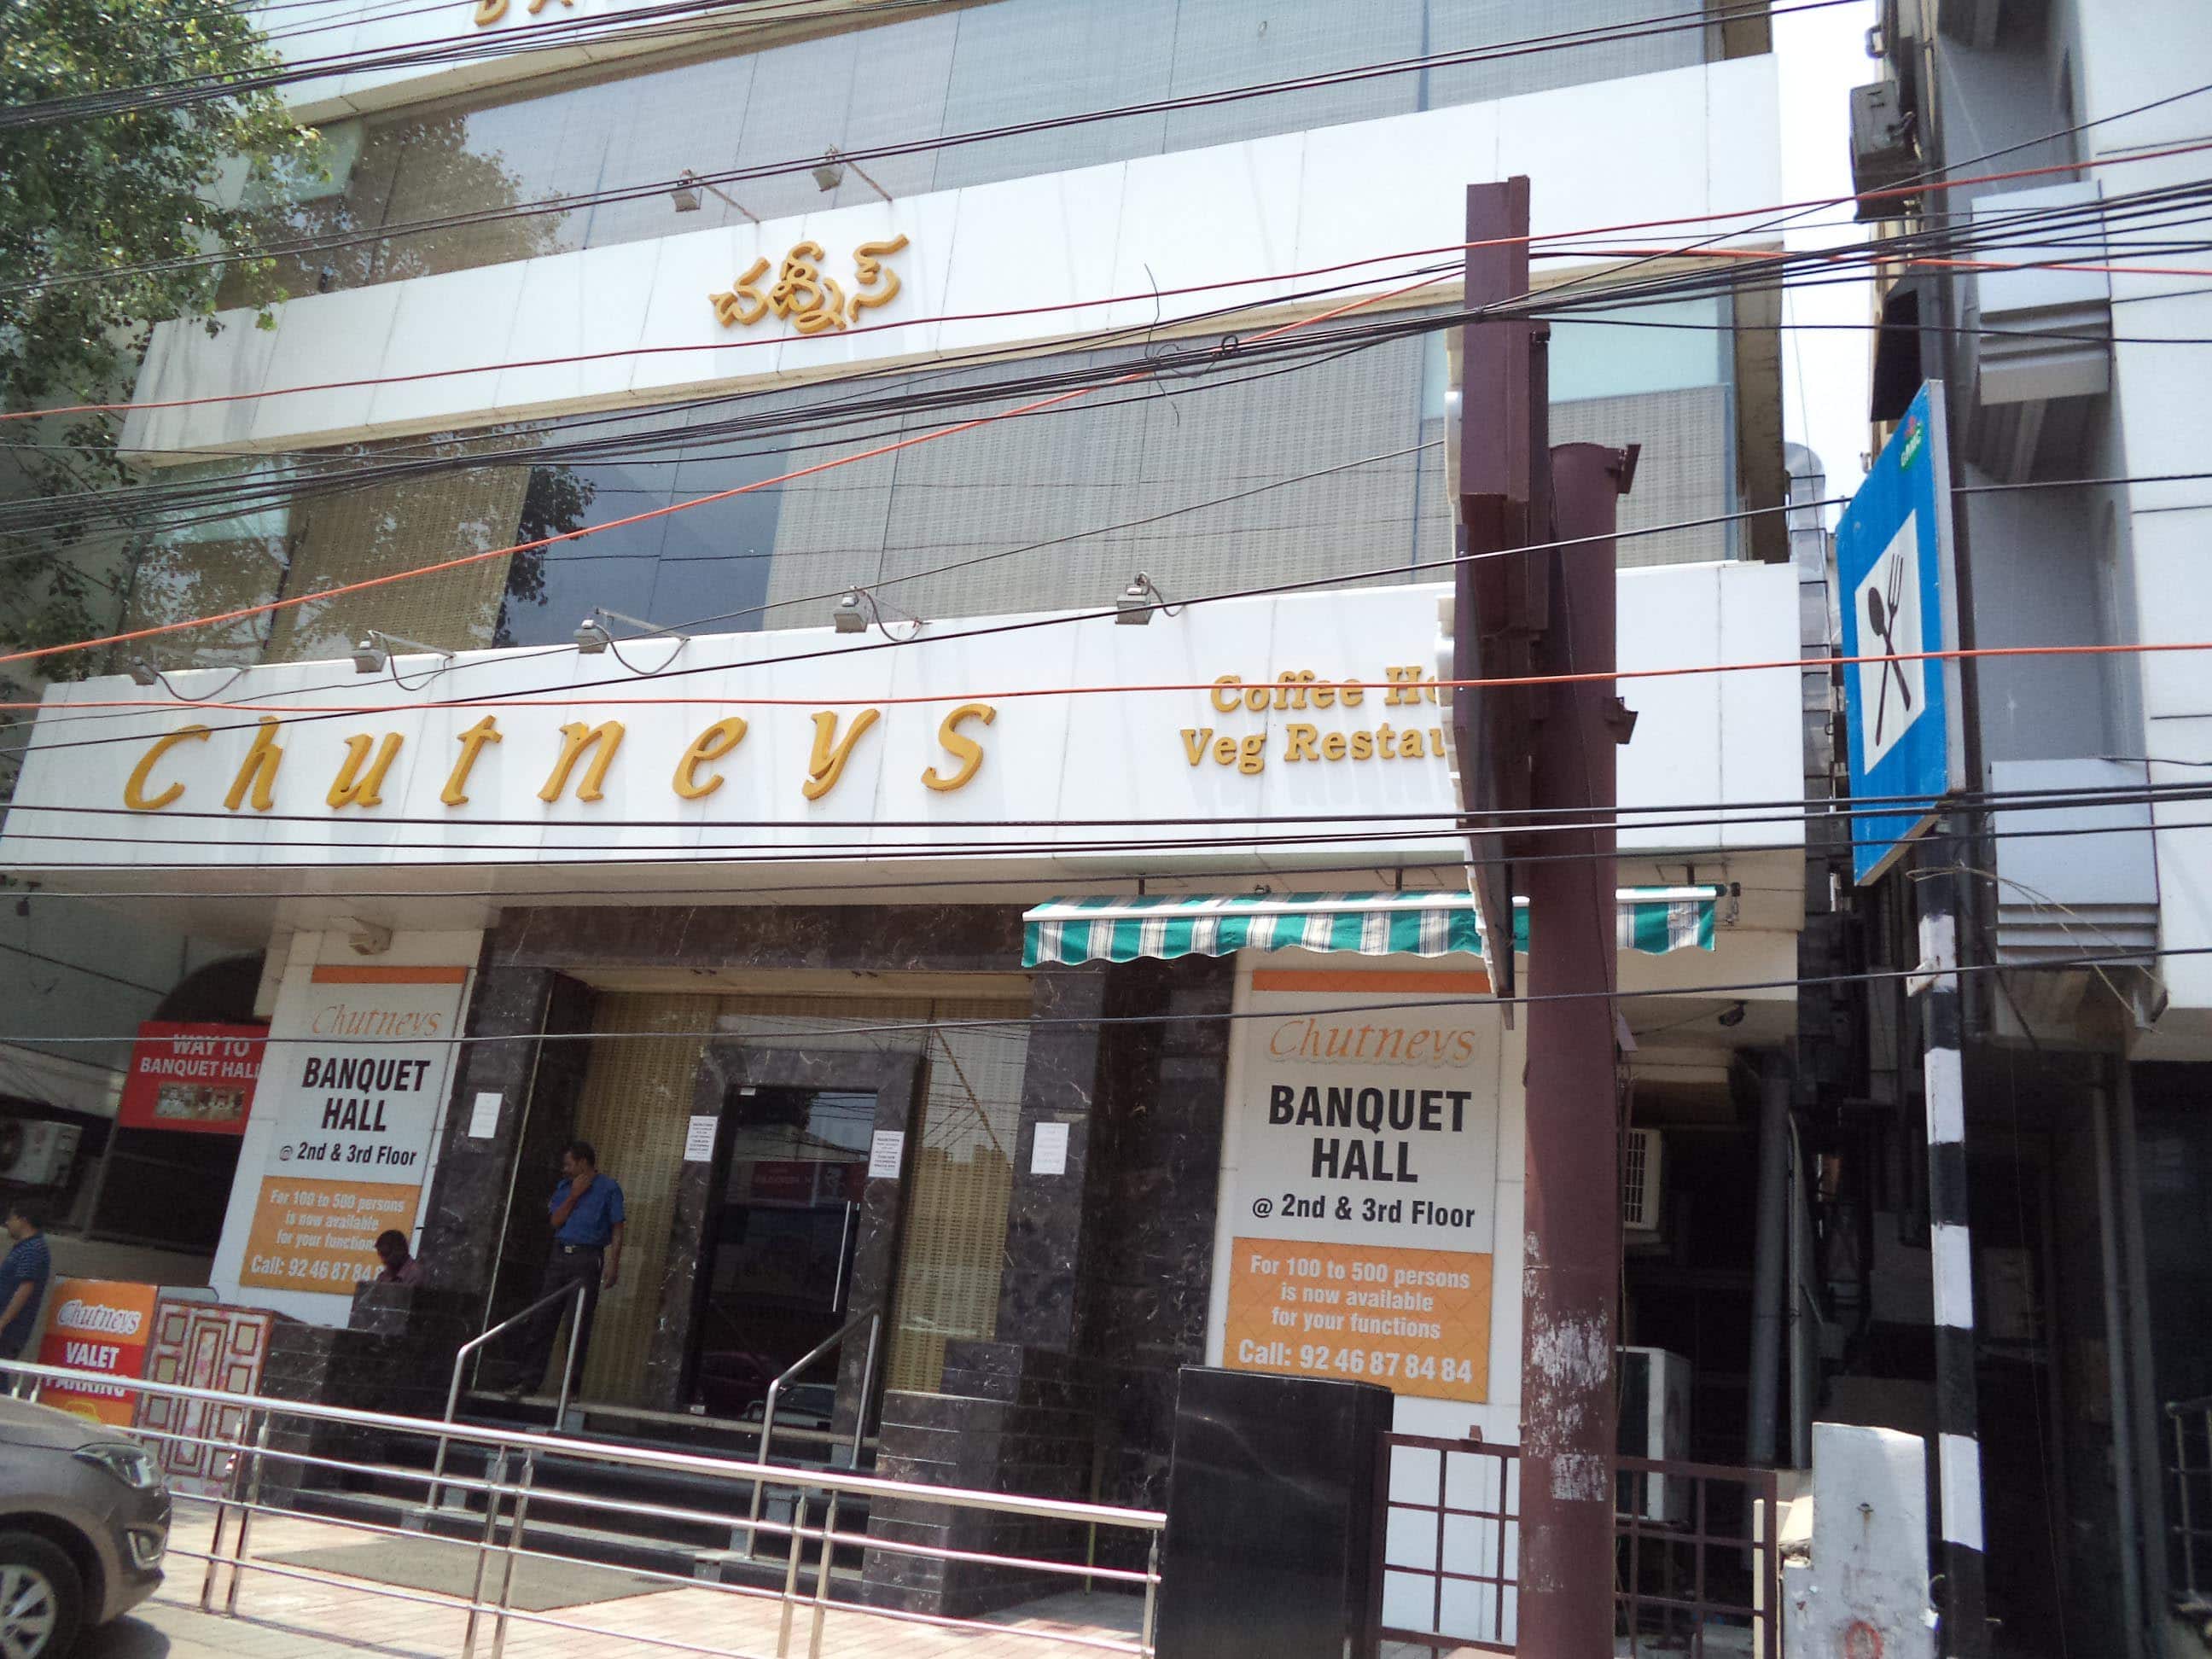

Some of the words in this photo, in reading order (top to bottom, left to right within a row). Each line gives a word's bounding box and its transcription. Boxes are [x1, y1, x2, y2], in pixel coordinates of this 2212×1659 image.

[1210, 669, 1365, 713] Coffee
[124, 702, 997, 812] Chutneys
[1180, 728, 1266, 775] Veg
[311, 1004, 442, 1037] Chutneys
[172, 1034, 217, 1056] WAY
[223, 1036, 250, 1057] TO
[1269, 1018, 1476, 1062] Chutneys
[140, 1057, 219, 1077] BANQUET
[301, 1057, 431, 1094] BANQUET
[321, 1097, 387, 1132] HALL
[1269, 1085, 1472, 1134] BANQUET
[297, 1142, 327, 1161] 2nd
[330, 1143, 342, 1162] &
[346, 1144, 374, 1164] 3rd
[376, 1146, 417, 1167] Floor
[1312, 1138, 1418, 1184] HALL
[270, 1190, 290, 1206] For
[317, 1193, 330, 1208] to
[357, 1197, 405, 1214] persons
[1253, 1197, 1273, 1219] @
[1281, 1193, 1325, 1219] 2nd
[1335, 1196, 1353, 1220] &
[1362, 1197, 1402, 1224] 3rd
[1412, 1200, 1476, 1228] Floor
[276, 1228, 294, 1245] for
[295, 1234, 322, 1249] your
[300, 1214, 325, 1228] now
[326, 1214, 381, 1231] available
[251, 1254, 284, 1275] Call:
[288, 1258, 310, 1278] 92
[331, 1261, 352, 1282] 87
[1250, 1254, 1279, 1275] For
[1286, 1257, 1321, 1278] 100
[1327, 1260, 1346, 1280] to
[1352, 1261, 1389, 1283] 500
[1394, 1267, 1470, 1289] persons
[1281, 1282, 1296, 1301] is
[1302, 1287, 1341, 1304] now
[1346, 1289, 1434, 1313] available
[57, 1300, 142, 1334] Chutneys
[1272, 1307, 1297, 1326] for
[1303, 1312, 1345, 1333] your
[1350, 1313, 1441, 1340] functions
[66, 1342, 119, 1369] VALET
[1238, 1338, 1291, 1367] Call:
[1300, 1344, 1330, 1371] 92
[1334, 1348, 1365, 1375] 46
[1369, 1351, 1400, 1377] 87
[1406, 1353, 1436, 1381] 84
[1441, 1357, 1473, 1384] 84
